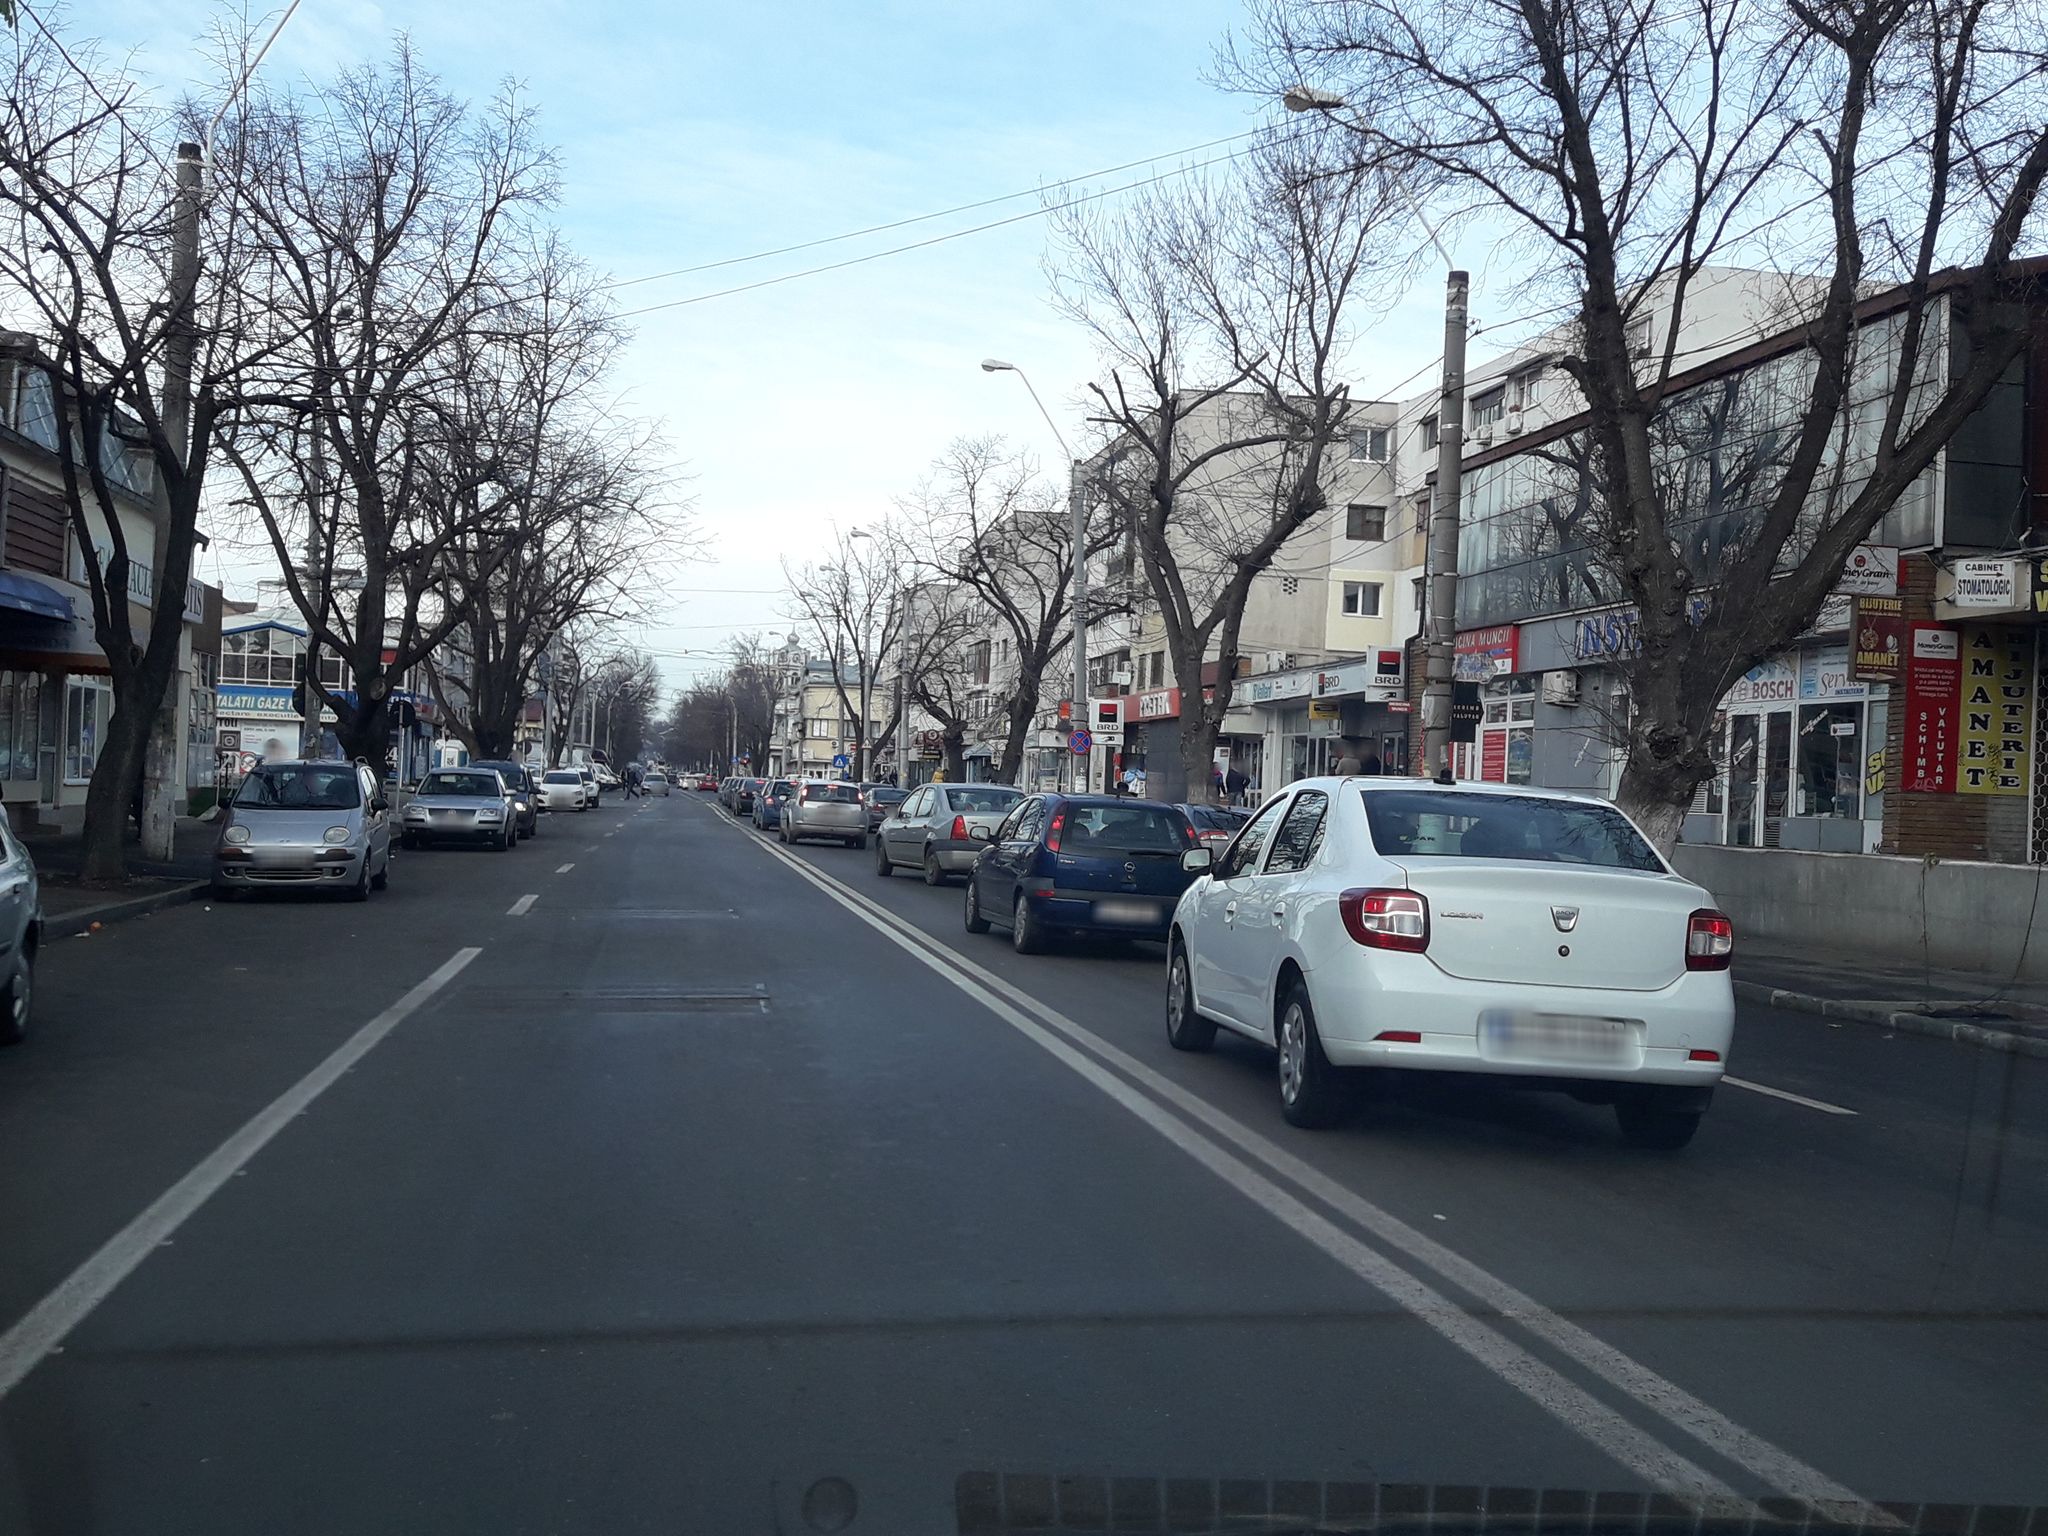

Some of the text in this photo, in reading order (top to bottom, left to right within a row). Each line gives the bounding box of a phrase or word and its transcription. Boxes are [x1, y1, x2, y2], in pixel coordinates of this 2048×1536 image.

[1843, 568, 1889, 579] neyGram
[1965, 563, 2004, 571] CABINET
[1957, 579, 2010, 596] STOMATOLOGIC
[1859, 597, 1902, 611] BIJUTERIE
[1479, 628, 1510, 646] MUNCII
[1856, 651, 1899, 667] AMANET
[1325, 675, 1340, 688] BRD
[1374, 676, 1402, 685] BRD
[1752, 680, 1794, 700] BOSCH
[257, 697, 286, 710] GAZE
[1966, 631, 1994, 786] AMANET
[1999, 633, 2026, 788] BIJUTERIE
[1097, 723, 1119, 731] BRD
[1917, 711, 1927, 778] SCHIMB
[1935, 707, 1947, 785] VALUTAR
